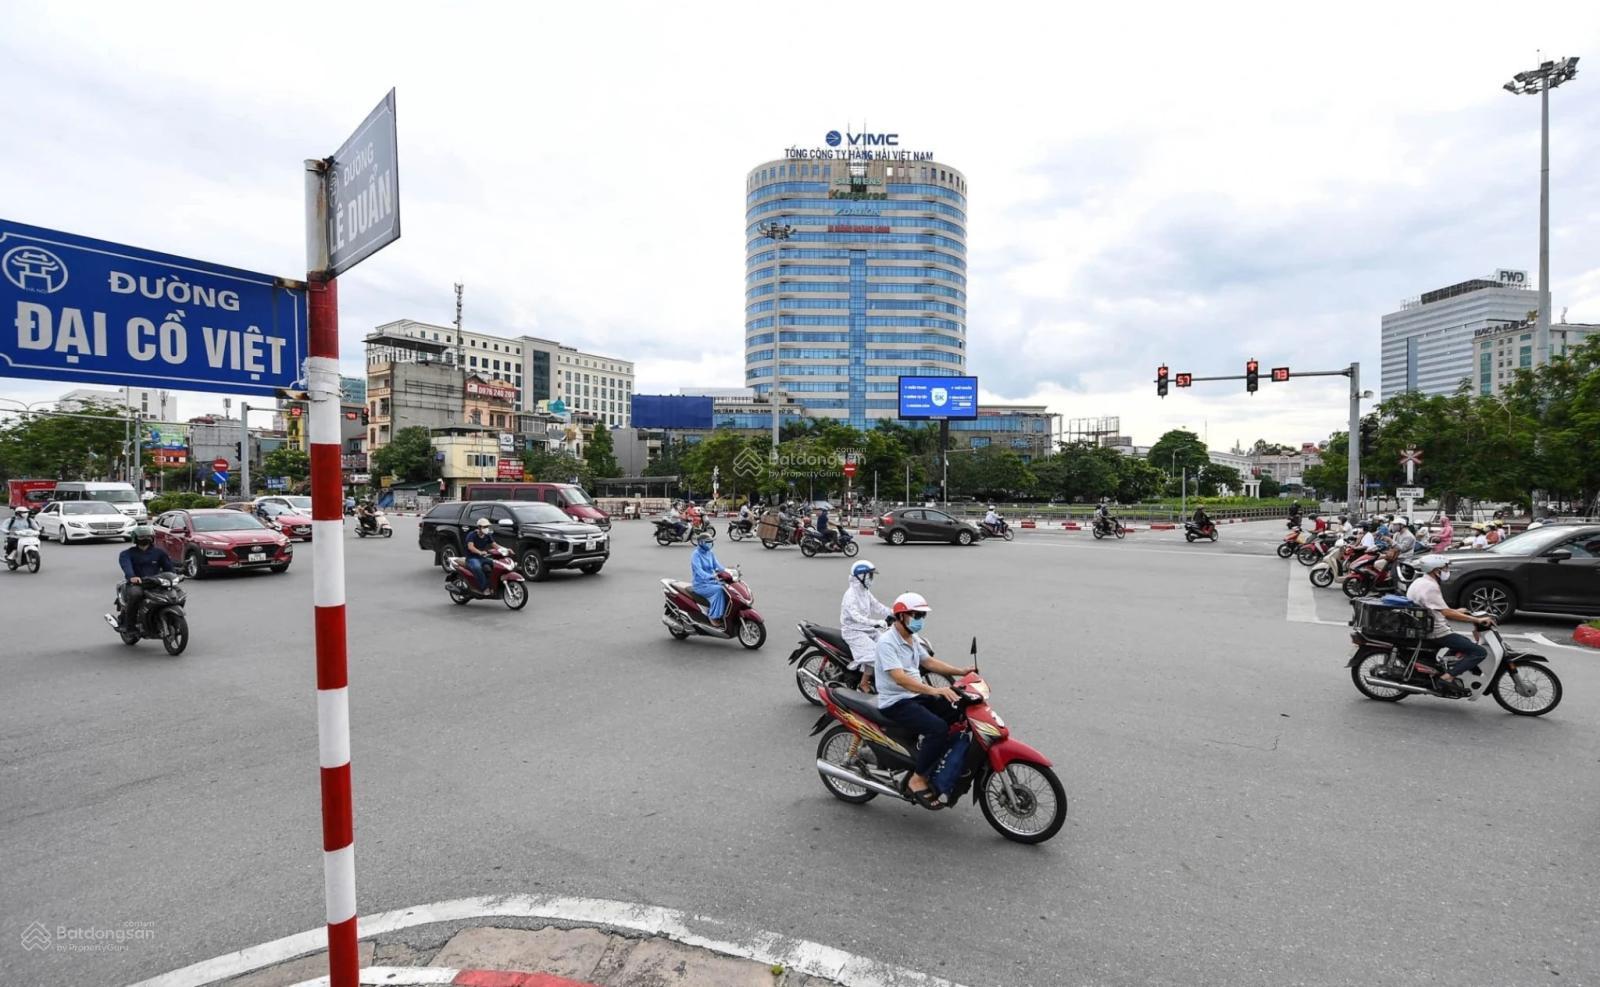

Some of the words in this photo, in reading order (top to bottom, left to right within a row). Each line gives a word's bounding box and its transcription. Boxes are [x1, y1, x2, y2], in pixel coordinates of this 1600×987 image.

[810, 146, 833, 159] CÔNG
[835, 149, 847, 160] TY
[848, 147, 873, 160] HÀNG
[892, 148, 911, 163] VIỆT
[913, 151, 933, 160] NAM
[846, 132, 899, 146] VIMC
[343, 141, 374, 187] ĐƯỜNG
[330, 202, 344, 255] LÊ
[348, 163, 391, 242] DUẨN
[108, 271, 240, 311] ĐƯỜNG
[1500, 271, 1524, 282] FWD
[14, 300, 108, 363] ĐẠI
[126, 309, 188, 365] CỒ
[202, 325, 286, 381] VIỆT
